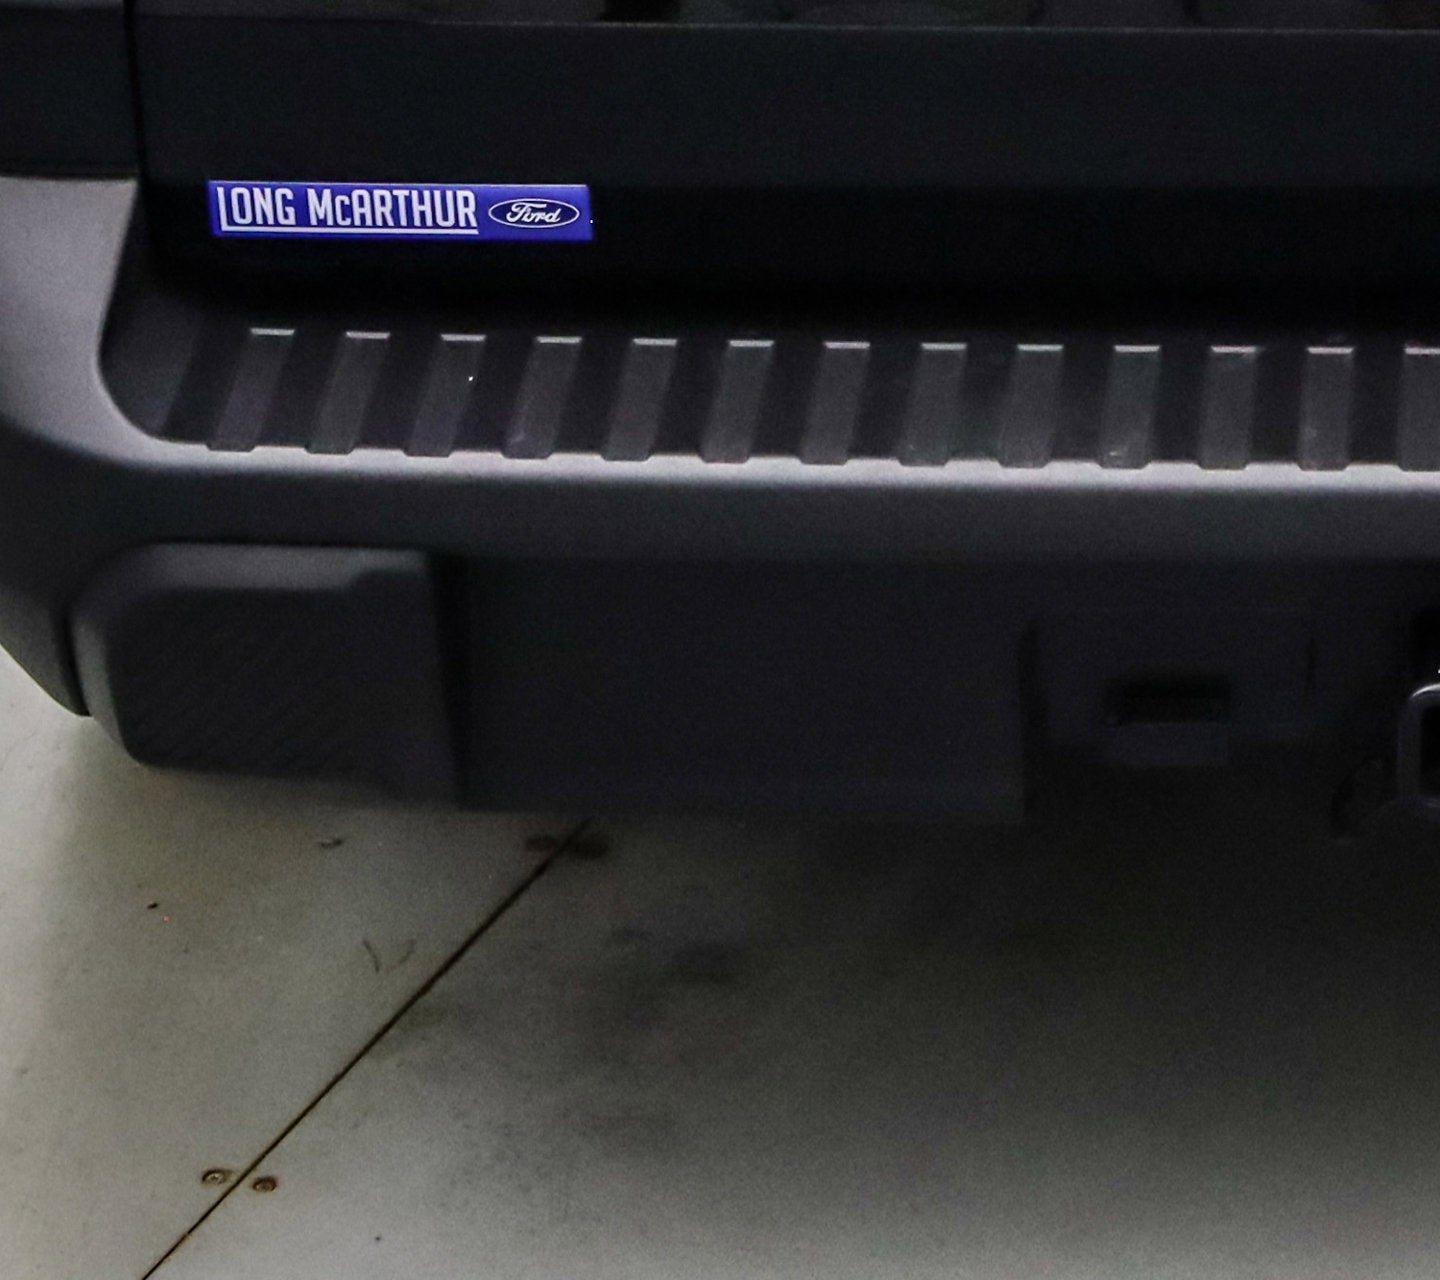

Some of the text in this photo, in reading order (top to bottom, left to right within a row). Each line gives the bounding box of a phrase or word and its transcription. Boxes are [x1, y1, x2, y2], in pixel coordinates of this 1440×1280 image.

[216, 186, 563, 232] LONG McARTHUR Ford
